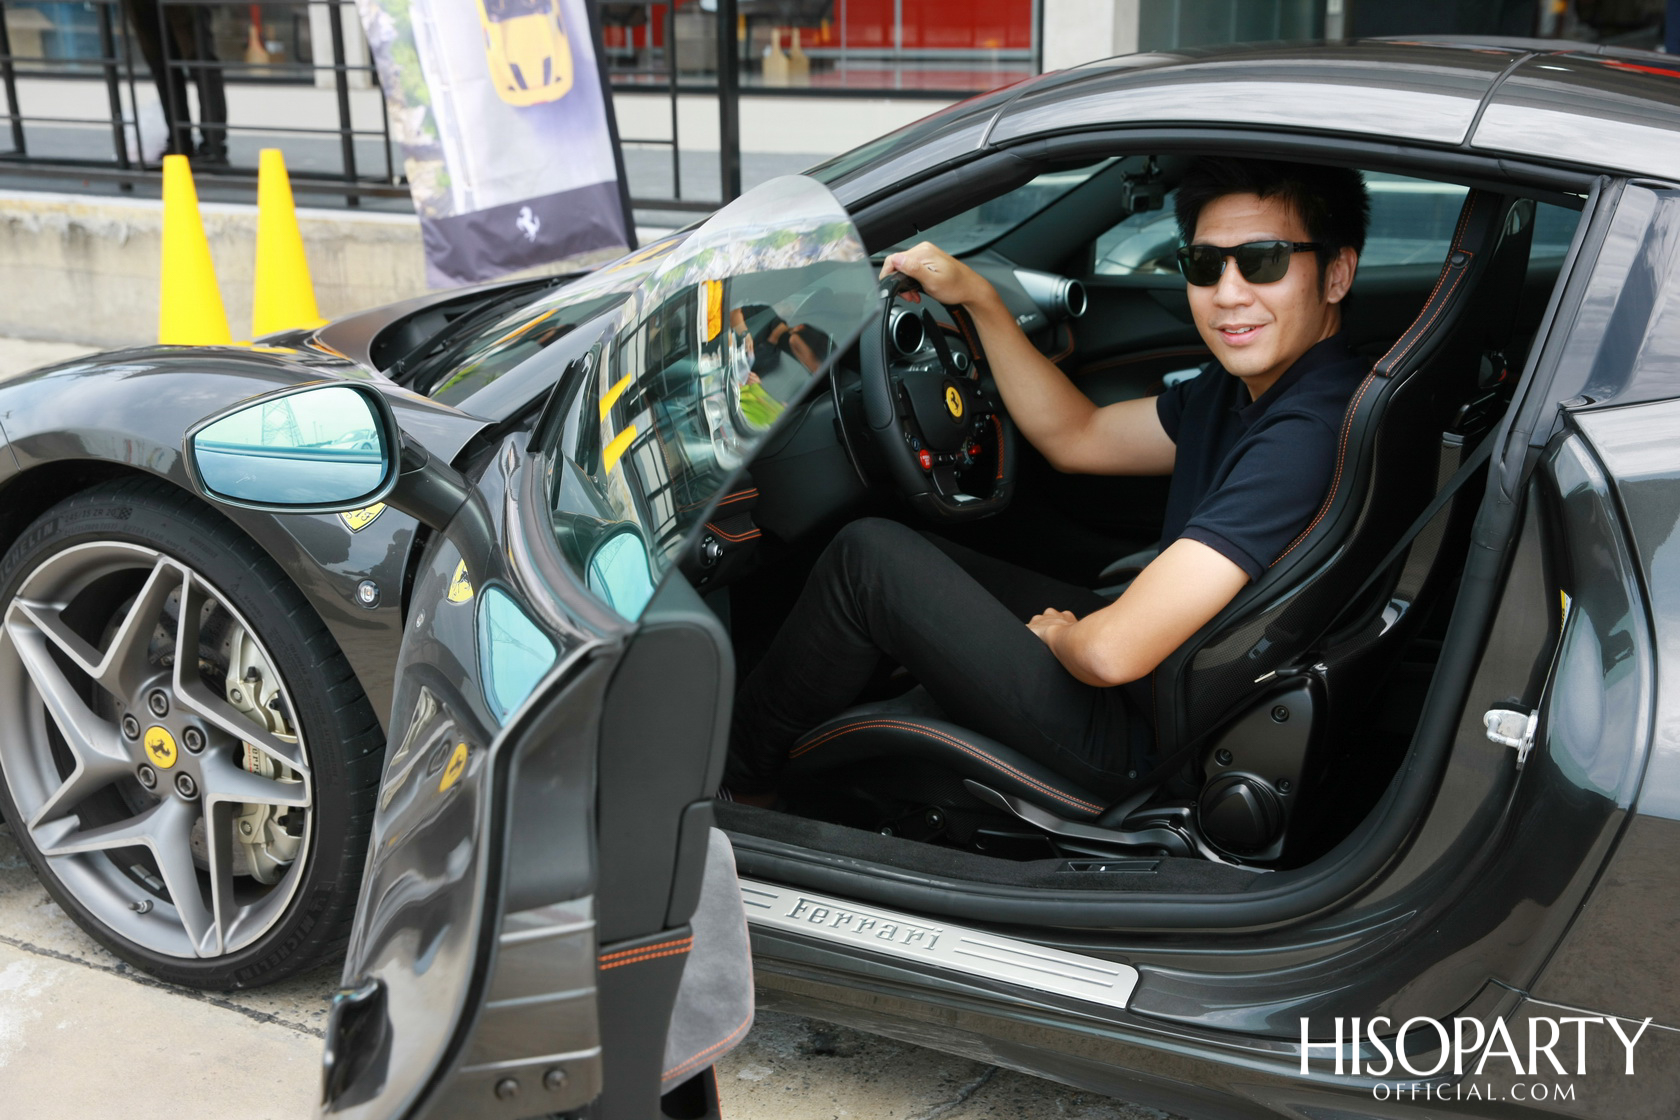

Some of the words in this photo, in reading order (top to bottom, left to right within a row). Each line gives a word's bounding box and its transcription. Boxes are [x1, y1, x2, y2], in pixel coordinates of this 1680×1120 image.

[0, 519, 55, 584] ICHELIN
[240, 914, 315, 981] MICHELIN
[785, 897, 943, 950] Ferrari
